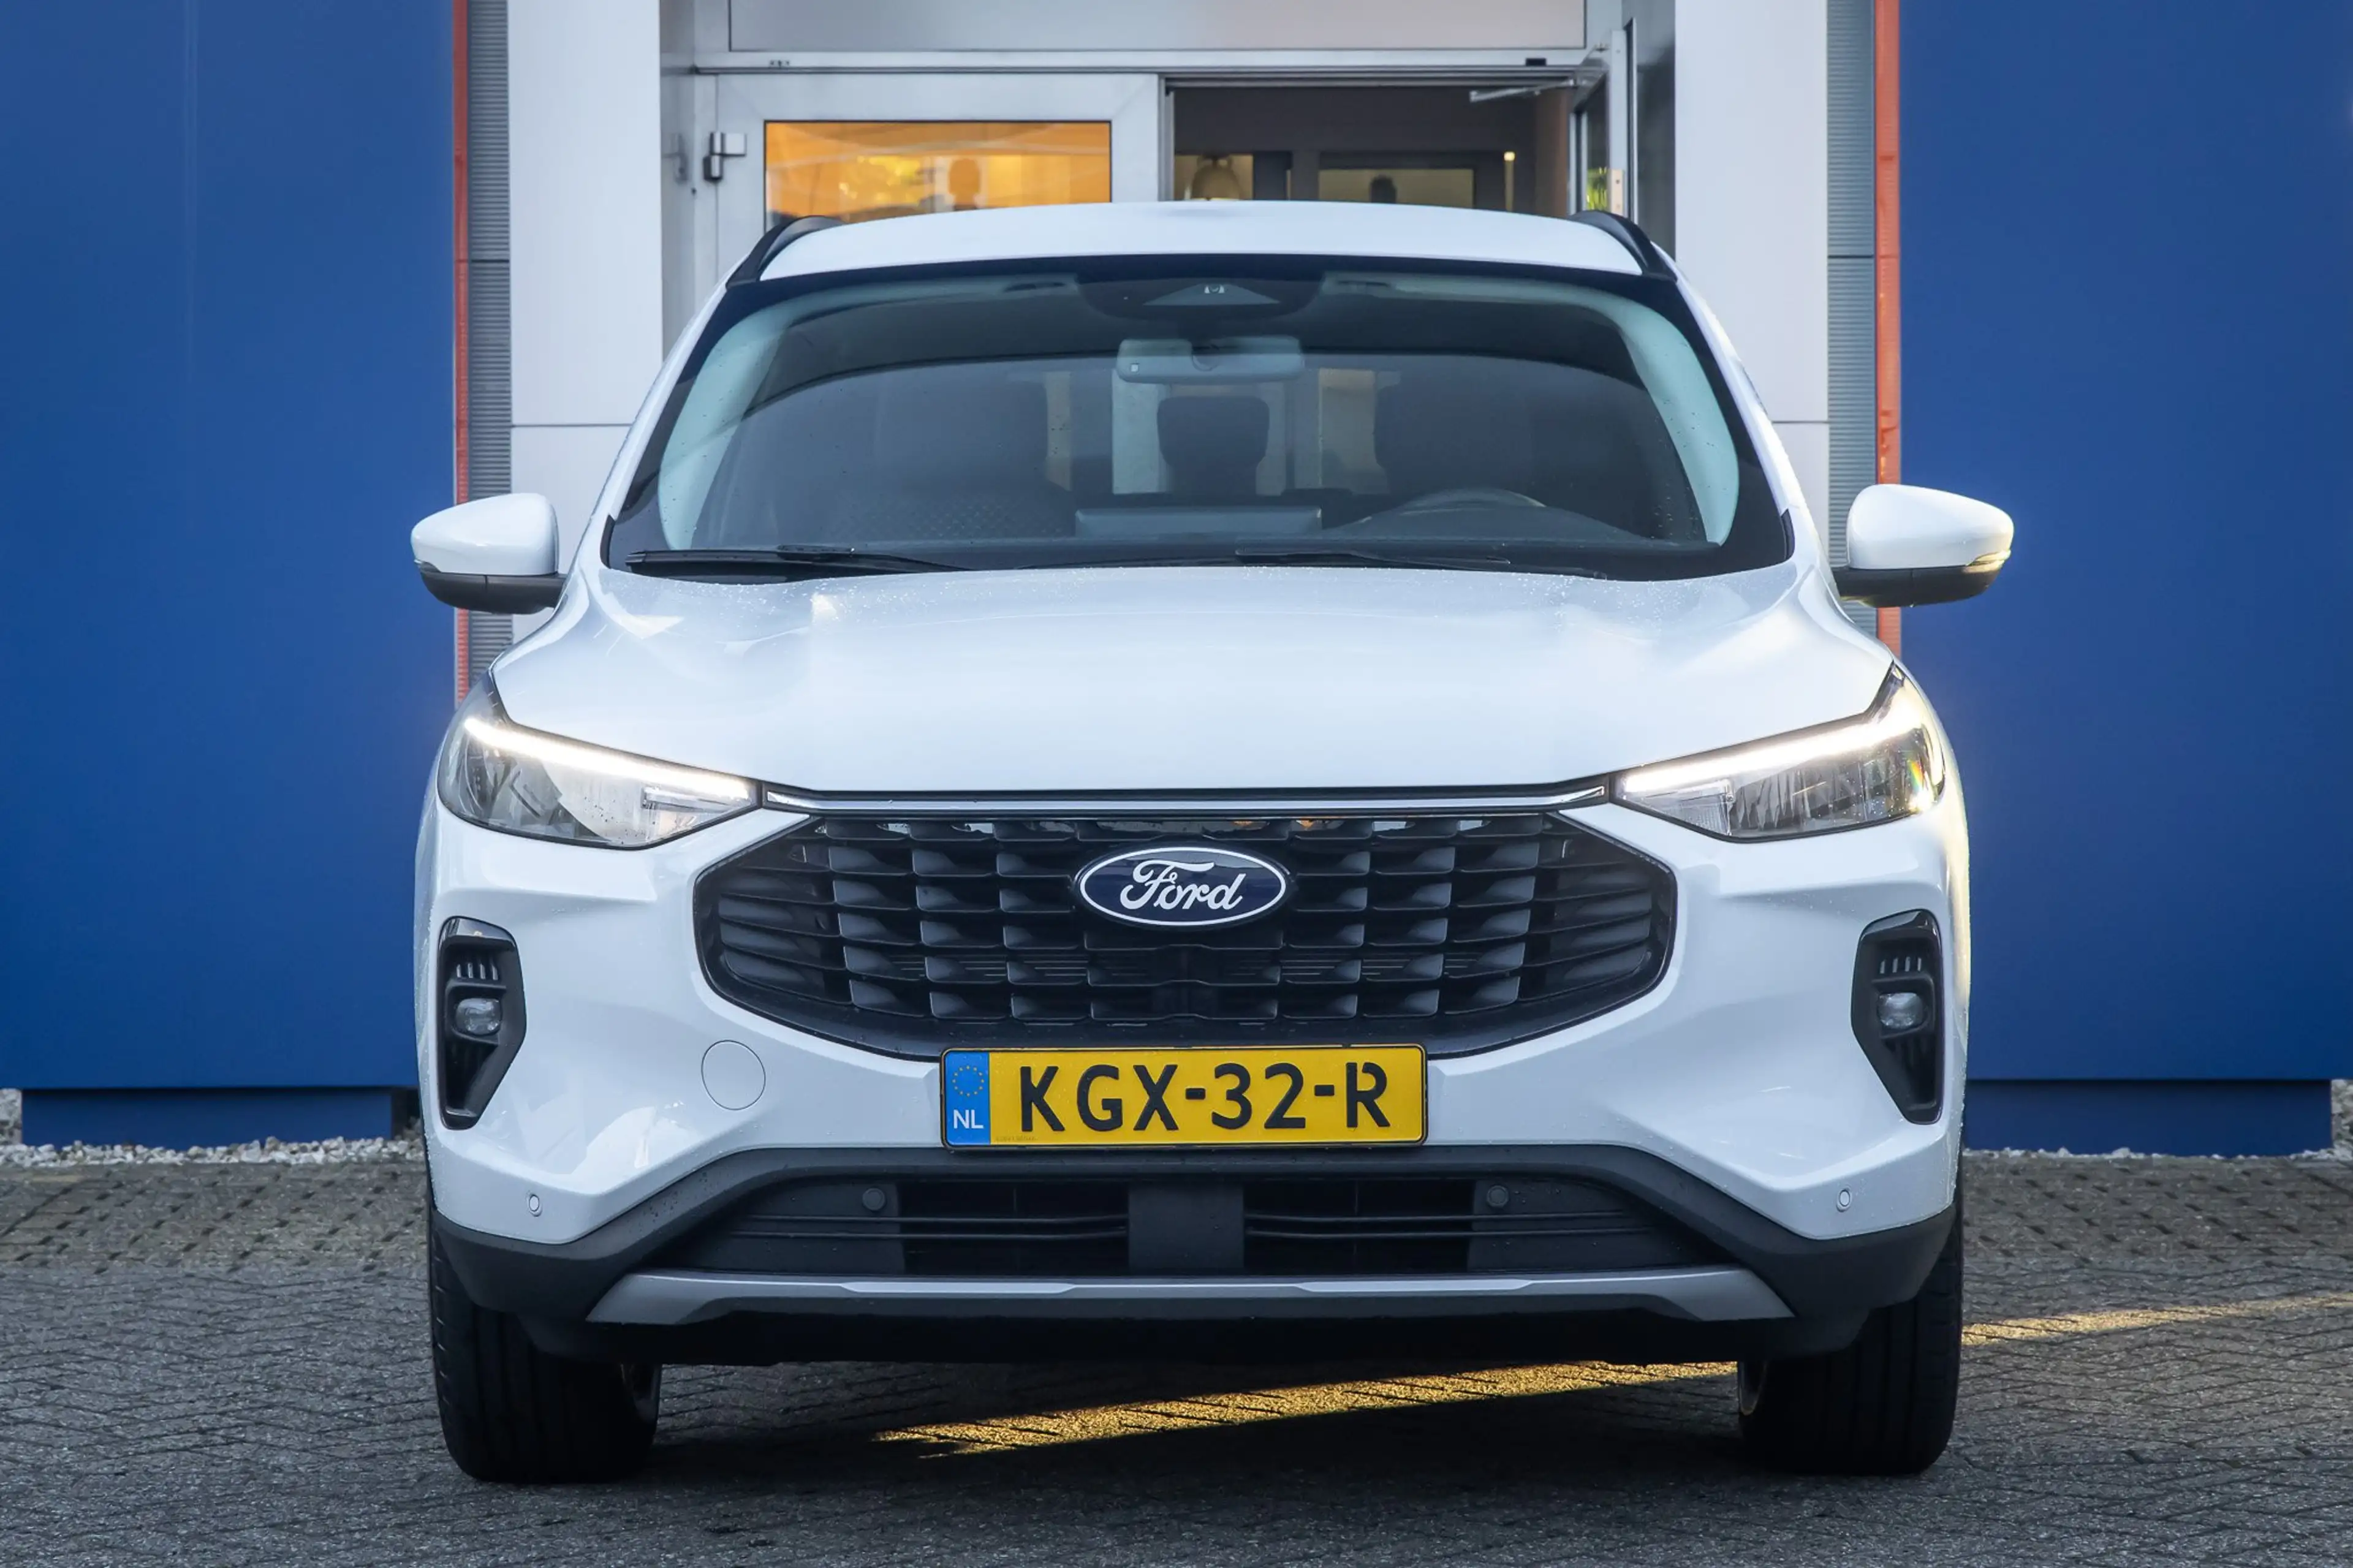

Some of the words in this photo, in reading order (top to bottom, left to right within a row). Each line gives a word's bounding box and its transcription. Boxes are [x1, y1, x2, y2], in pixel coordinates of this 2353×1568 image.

[1120, 859, 1247, 910] Ford
[953, 1109, 983, 1129] NL
[1020, 1062, 1391, 1132] KGX-32-R
